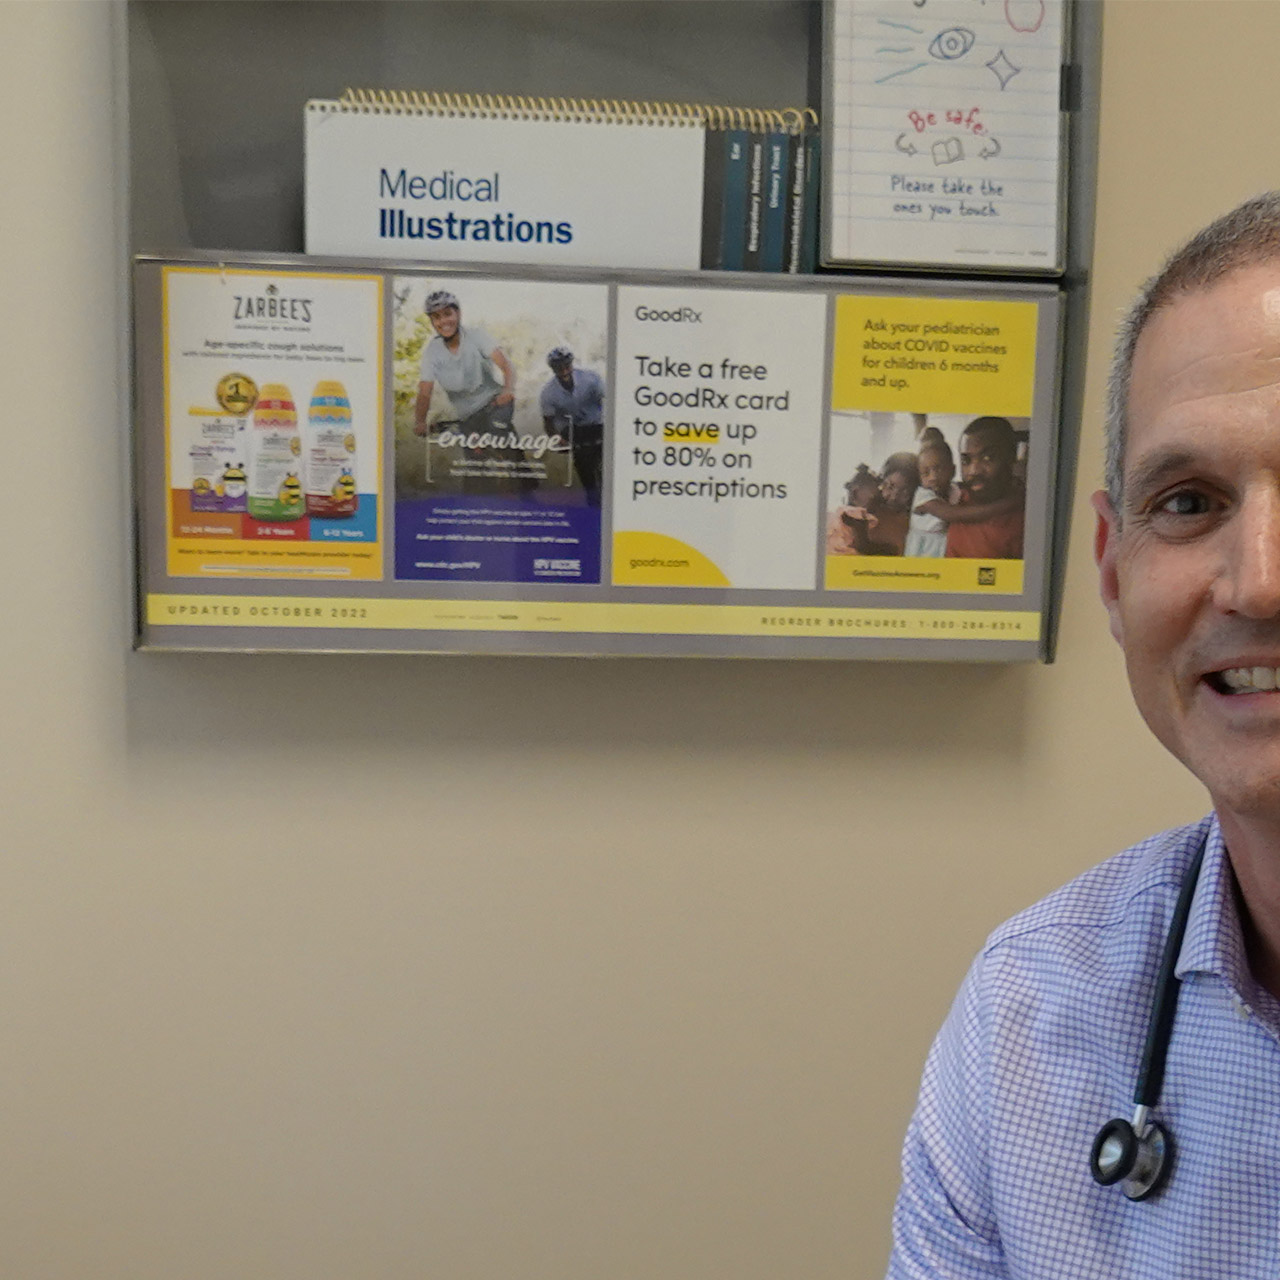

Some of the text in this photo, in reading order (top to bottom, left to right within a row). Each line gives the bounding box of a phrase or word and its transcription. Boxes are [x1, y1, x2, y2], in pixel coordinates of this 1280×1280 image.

[909, 110, 937, 132] Be
[379, 167, 500, 202] Medical
[890, 174, 1005, 197] Please take the
[893, 204, 922, 214] ones
[929, 203, 952, 220] you
[379, 208, 573, 244] Illustrations
[635, 305, 703, 323] GoodRx
[864, 318, 1000, 336] Ask your pediatrician
[863, 338, 1008, 355] about COVID vaccines
[634, 356, 768, 380] Take a free
[862, 355, 881, 369] for
[884, 357, 936, 371] children
[951, 360, 1000, 374] months
[860, 374, 910, 391] and up.
[634, 386, 790, 411] GoodRx card
[633, 417, 757, 446] to save up
[436, 431, 570, 459] encourage
[633, 446, 752, 469] to 80% on
[632, 476, 788, 503] prescriptions
[629, 557, 690, 569] goodrx.com
[168, 605, 368, 618] UPDATED OCTOBER 2022
[761, 616, 822, 627] REORDER
[828, 618, 908, 629] BROCHURES
